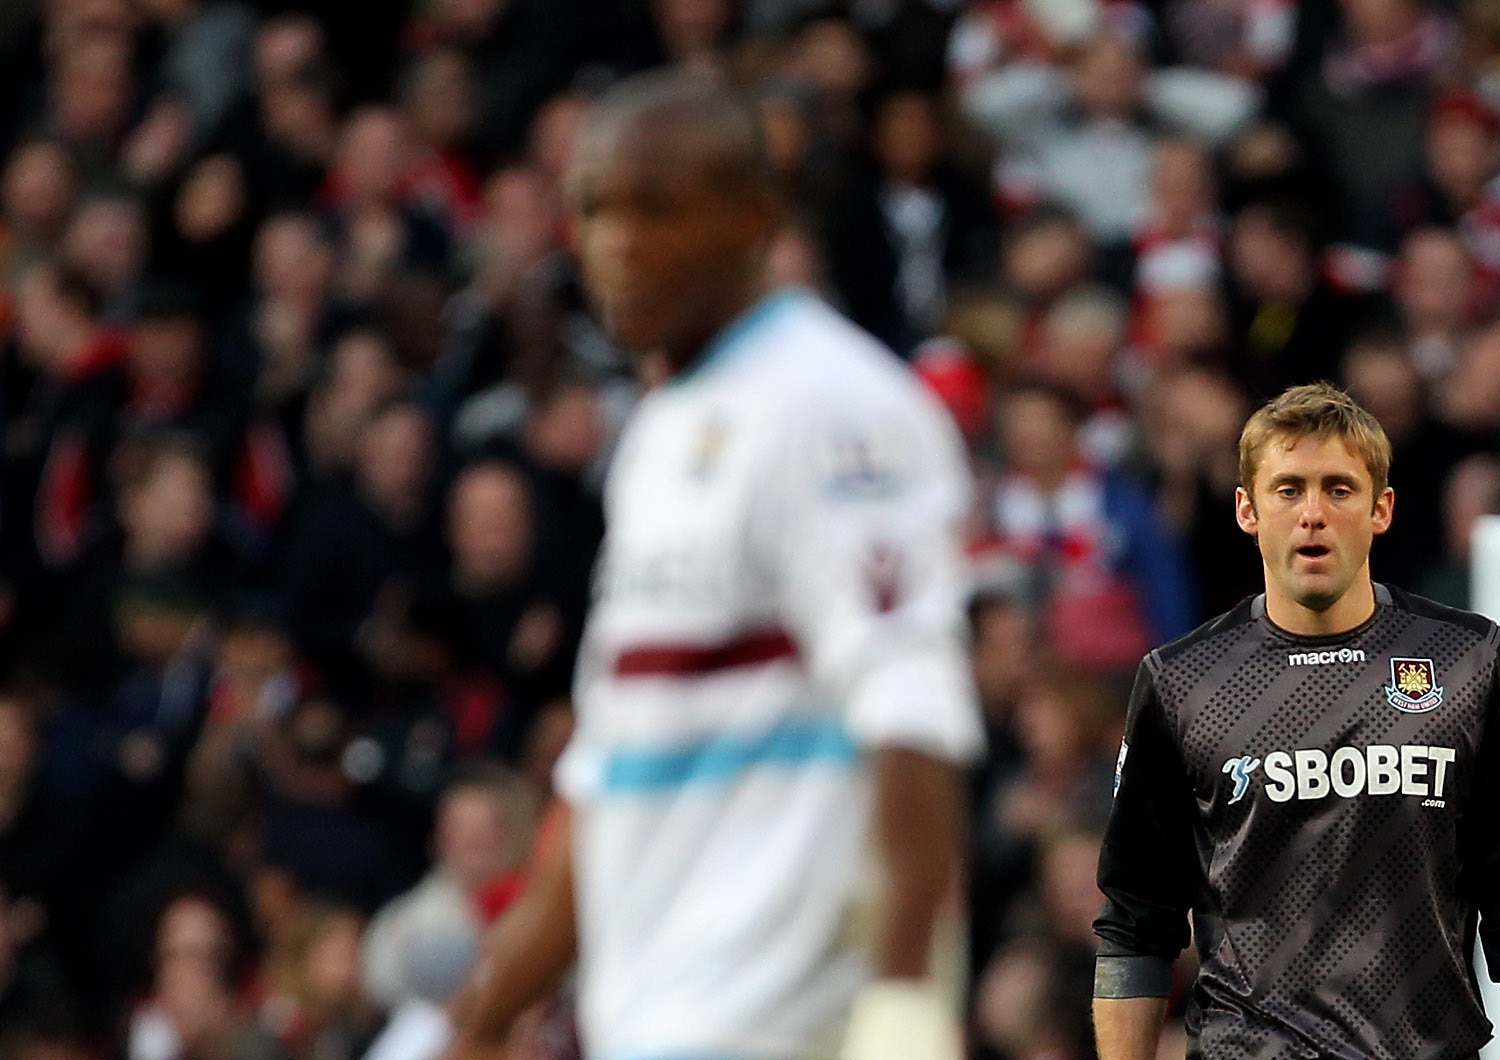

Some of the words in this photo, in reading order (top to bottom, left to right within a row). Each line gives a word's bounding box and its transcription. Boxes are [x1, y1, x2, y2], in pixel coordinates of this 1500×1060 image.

[1288, 648, 1366, 666] macron
[1263, 744, 1457, 803] SBOBET
[1421, 798, 1446, 809] .com
